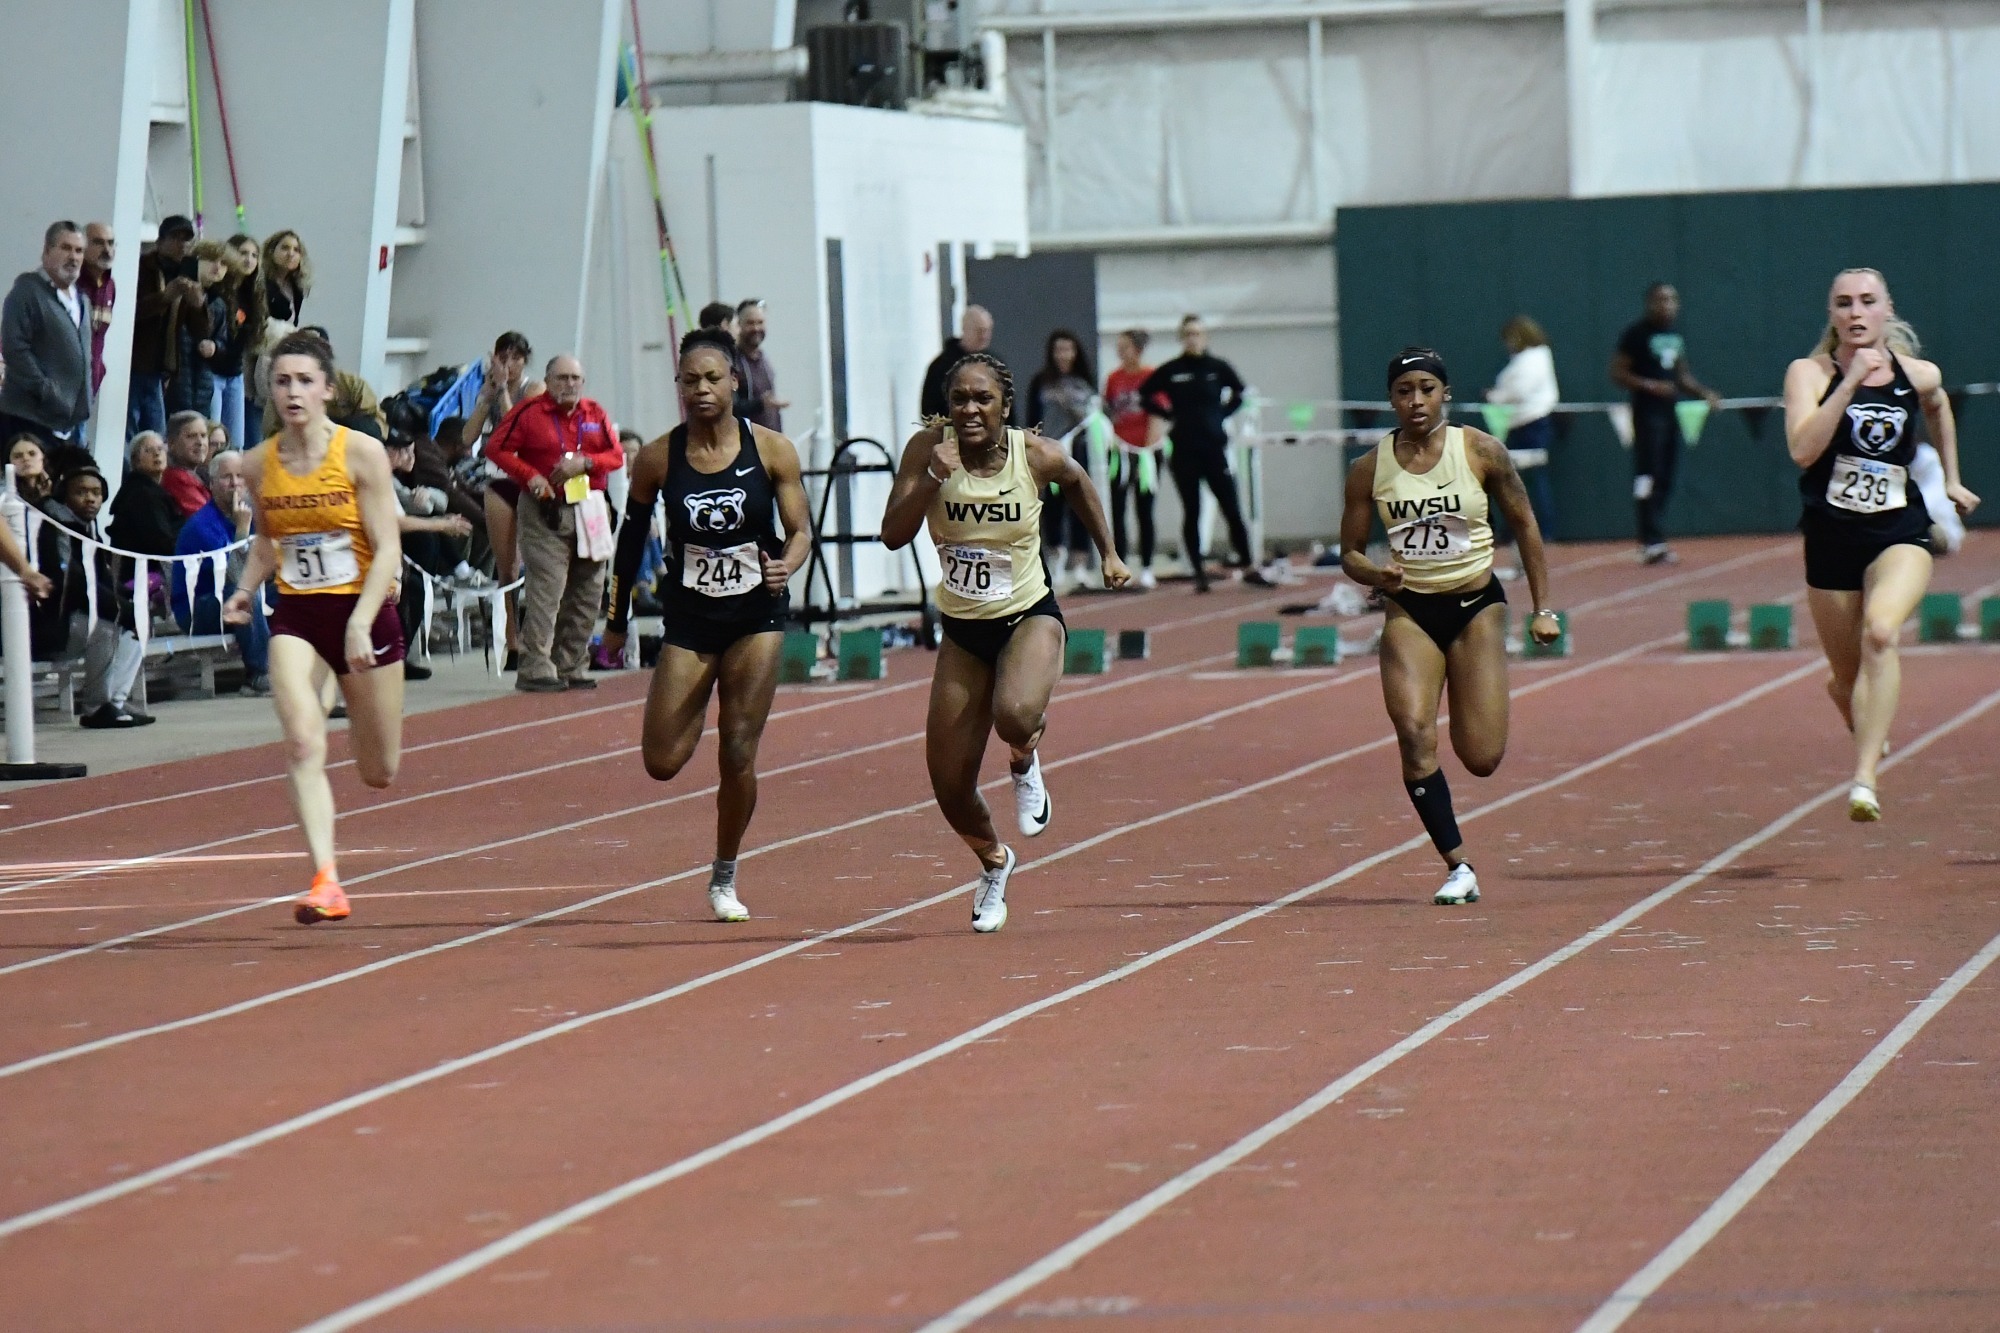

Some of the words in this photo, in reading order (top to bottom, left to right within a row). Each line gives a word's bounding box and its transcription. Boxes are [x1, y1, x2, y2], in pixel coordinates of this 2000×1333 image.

[1841, 471, 1888, 506] 239
[945, 501, 1020, 524] WVSU
[1387, 494, 1461, 519] WVSU
[1403, 524, 1449, 549] 273
[296, 546, 326, 578] 51
[955, 549, 984, 560] EAST
[696, 558, 742, 586] 244
[947, 556, 991, 590] 276
